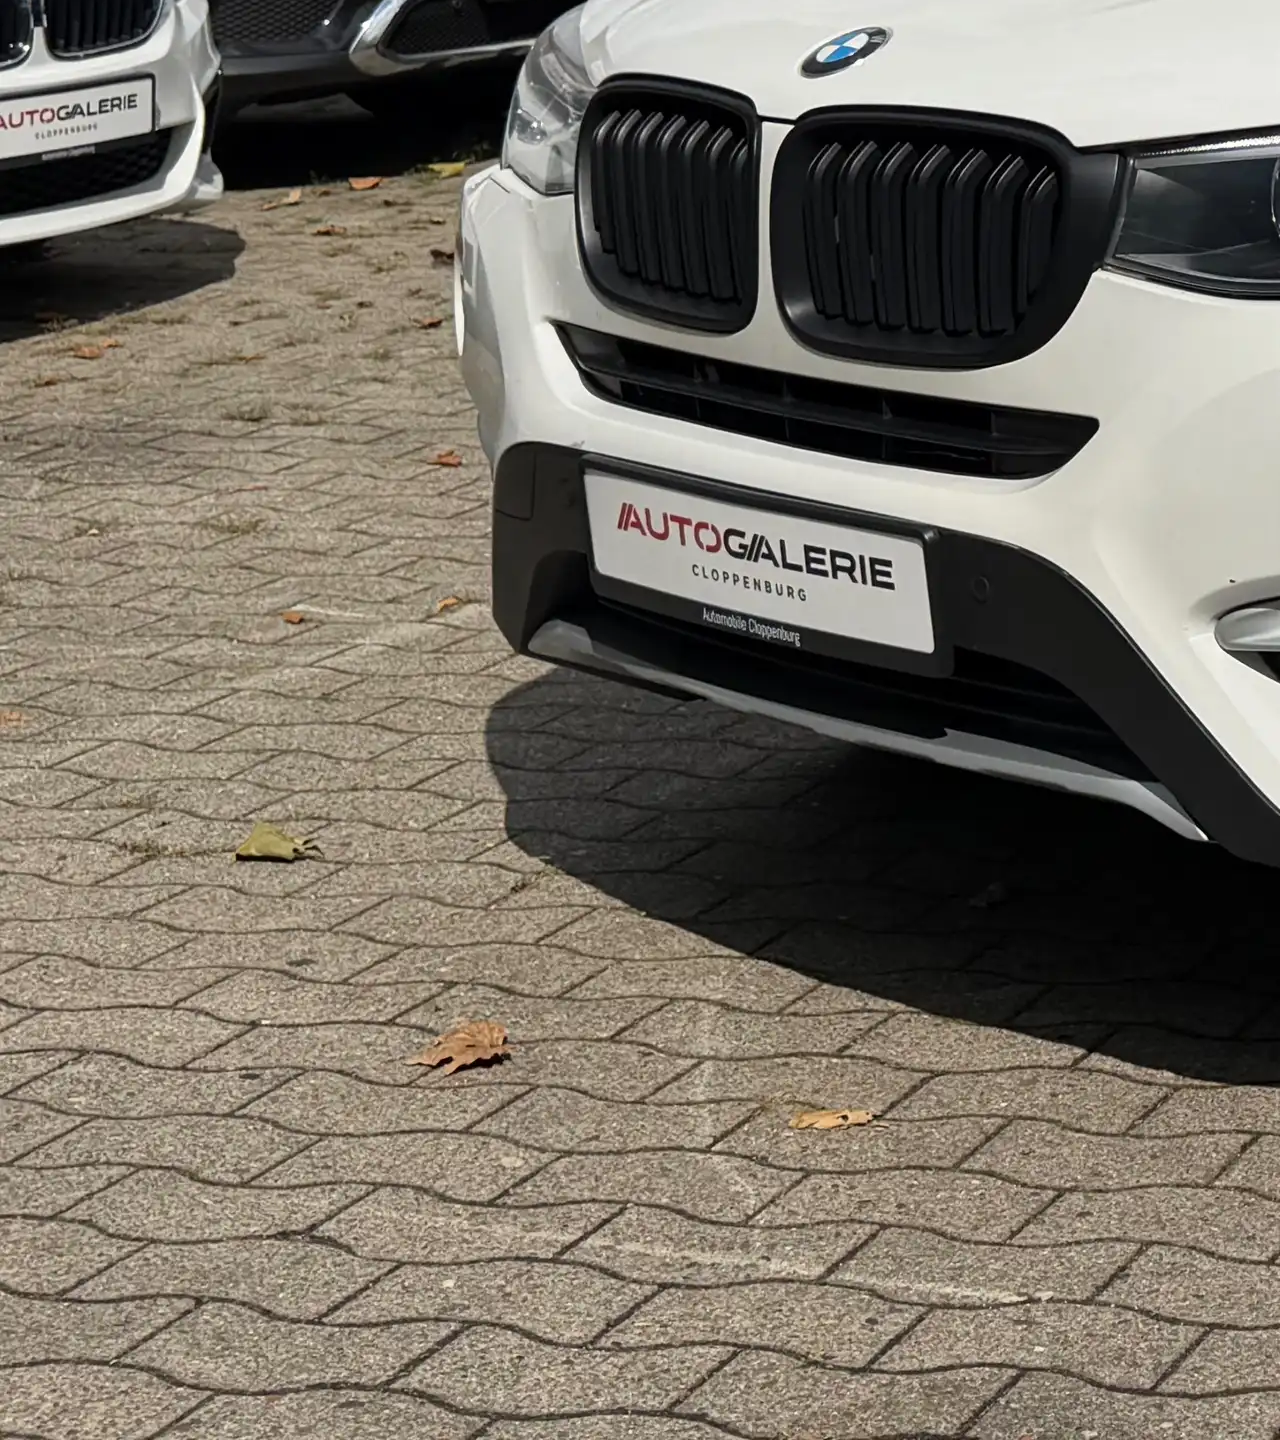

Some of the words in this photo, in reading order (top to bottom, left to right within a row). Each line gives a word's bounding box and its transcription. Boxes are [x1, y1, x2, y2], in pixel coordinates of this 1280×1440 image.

[617, 502, 895, 590] AUTOGALERIE
[692, 564, 807, 601] CLOPPENBURG
[703, 607, 747, 631] Automobile
[748, 618, 801, 647] Cloppenburg
